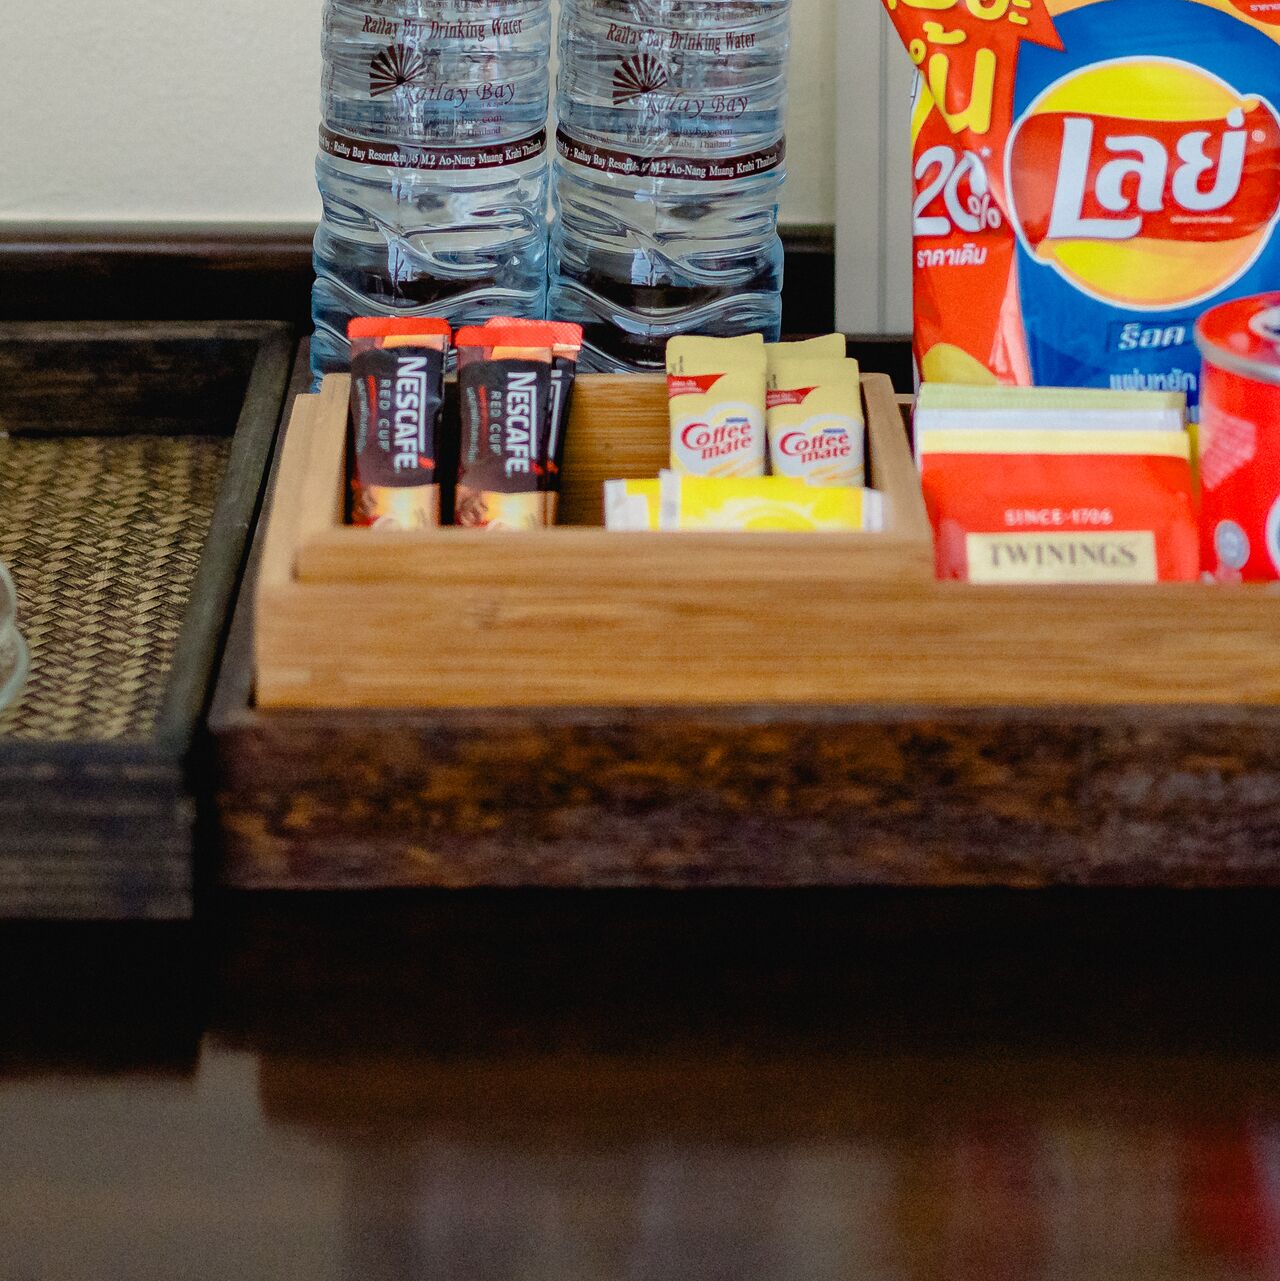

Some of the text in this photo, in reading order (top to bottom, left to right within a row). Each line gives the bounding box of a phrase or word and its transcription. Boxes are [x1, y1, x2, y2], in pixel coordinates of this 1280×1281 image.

[362, 14, 523, 41] Railay Bay Drinking Water
[606, 23, 757, 54] Railay Bay Drinking Water
[476, 81, 516, 104] Bay
[711, 94, 750, 119] Bay
[334, 140, 351, 157] Railay
[352, 146, 366, 160] Bay
[439, 154, 476, 167] Ao-Nang
[478, 152, 504, 164] Muang
[505, 146, 522, 160] Krabi
[522, 139, 541, 156] Thailand
[574, 148, 592, 164] Railay
[593, 154, 607, 168] Bay
[669, 163, 707, 178] Ao-Nang
[709, 165, 735, 178] Muang
[736, 160, 755, 174] Krabi
[755, 152, 778, 169] Thailand
[1047, 107, 1248, 240] เลย์
[916, 242, 988, 269] ราคาเดิม
[377, 379, 391, 451] RED CUP
[488, 390, 502, 455] RED CUP
[681, 422, 752, 451] Coffee
[701, 435, 753, 460] mate
[778, 431, 850, 456] Coffee
[800, 444, 851, 464] mate
[991, 542, 1137, 567] TWININGS
